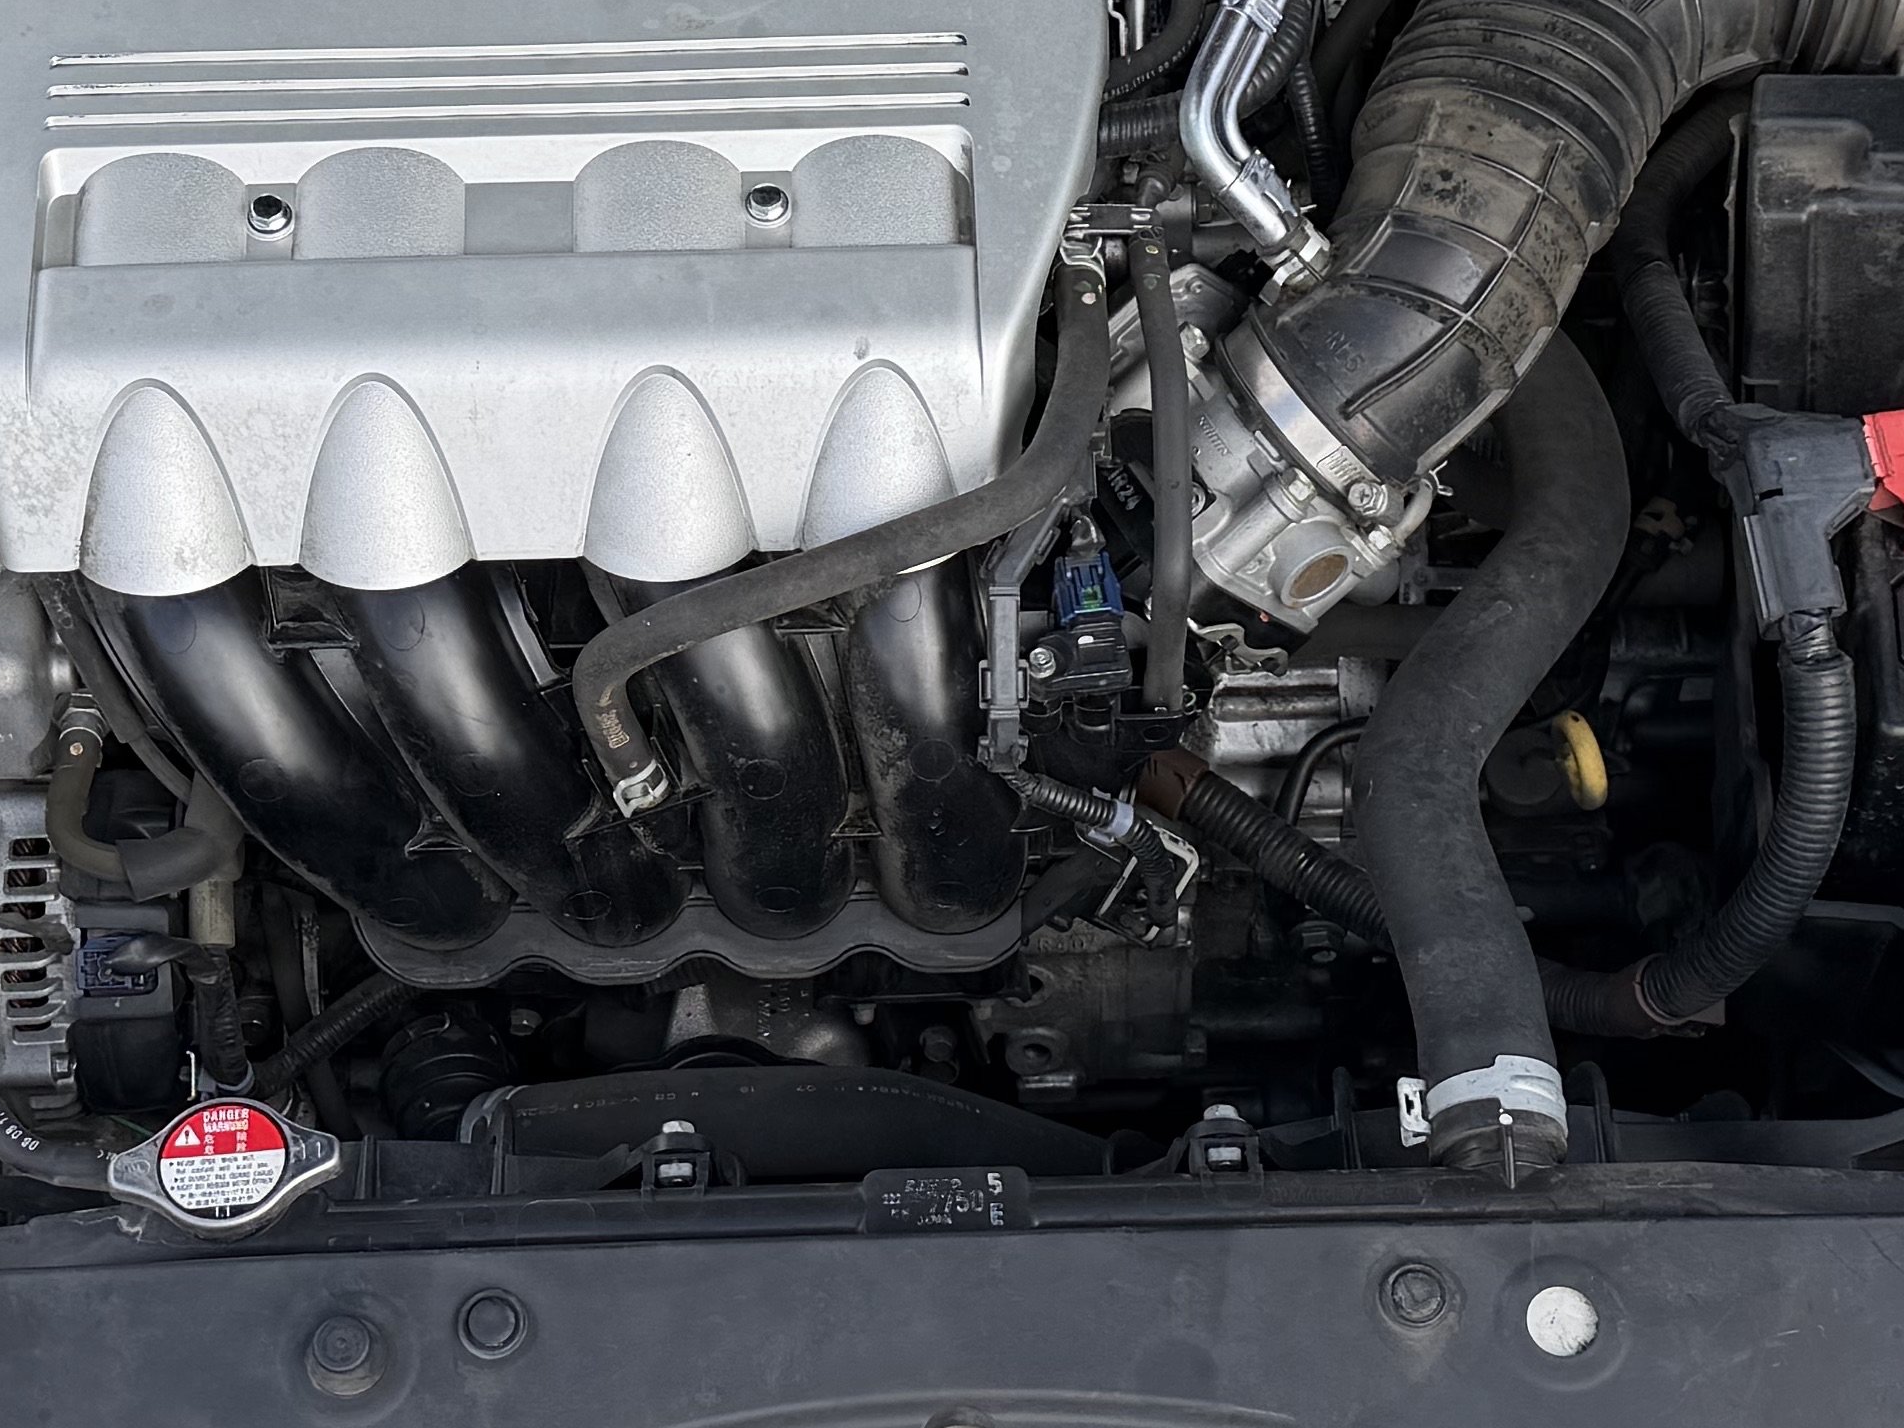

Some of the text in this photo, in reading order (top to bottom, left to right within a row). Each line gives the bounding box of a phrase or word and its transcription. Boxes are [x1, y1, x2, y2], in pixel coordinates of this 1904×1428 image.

[203, 1108, 250, 1122] DANGER
[987, 1172, 1004, 1196] 5
[989, 1202, 1005, 1226] E
